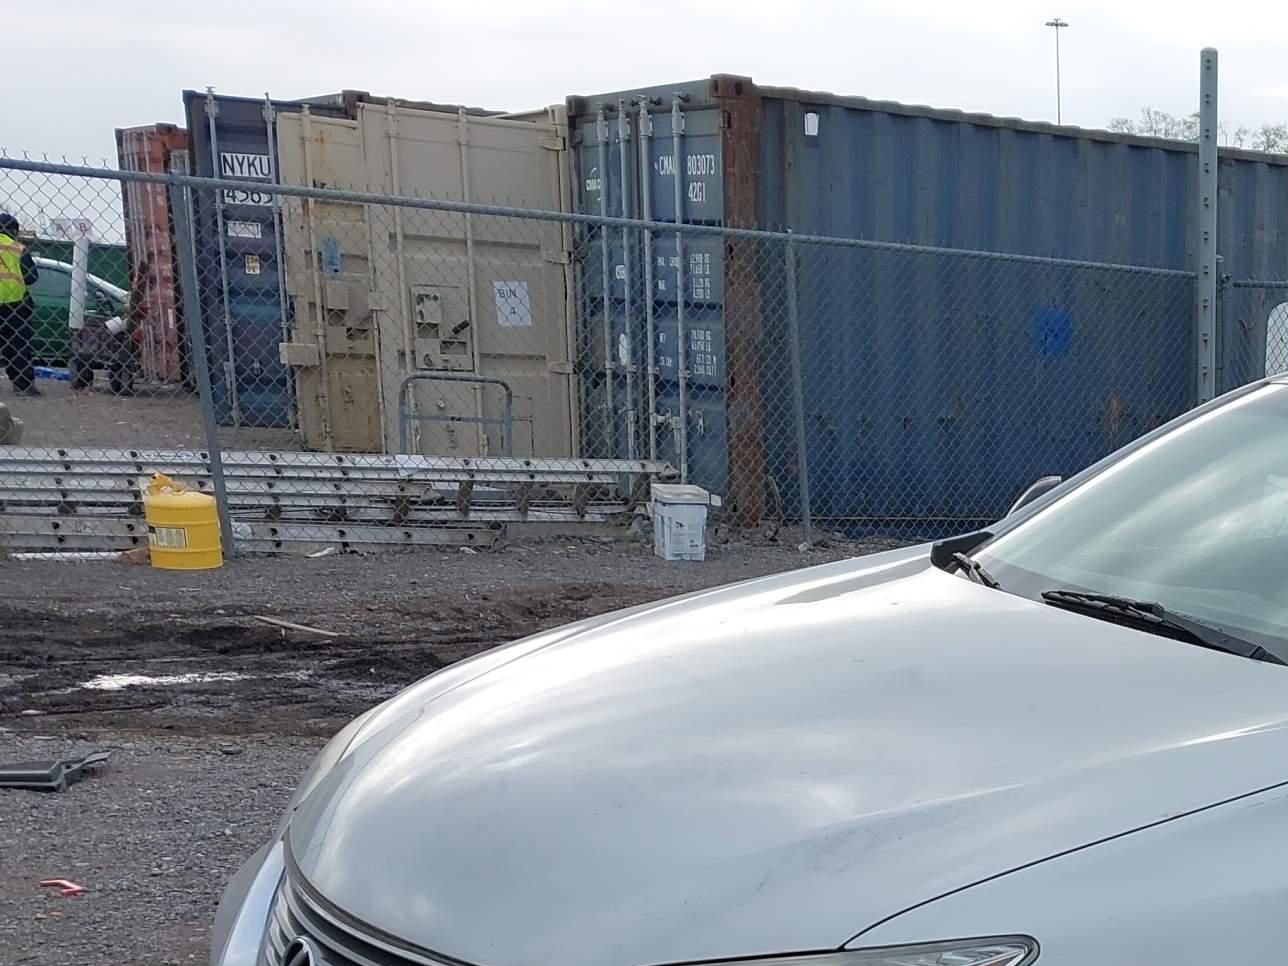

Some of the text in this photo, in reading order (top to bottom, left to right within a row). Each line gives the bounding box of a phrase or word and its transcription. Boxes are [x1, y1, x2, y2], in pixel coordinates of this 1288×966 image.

[222, 154, 271, 176] NYKU
[687, 154, 715, 175] 803073
[688, 182, 706, 202] 42G1
[499, 288, 517, 299] BIN
